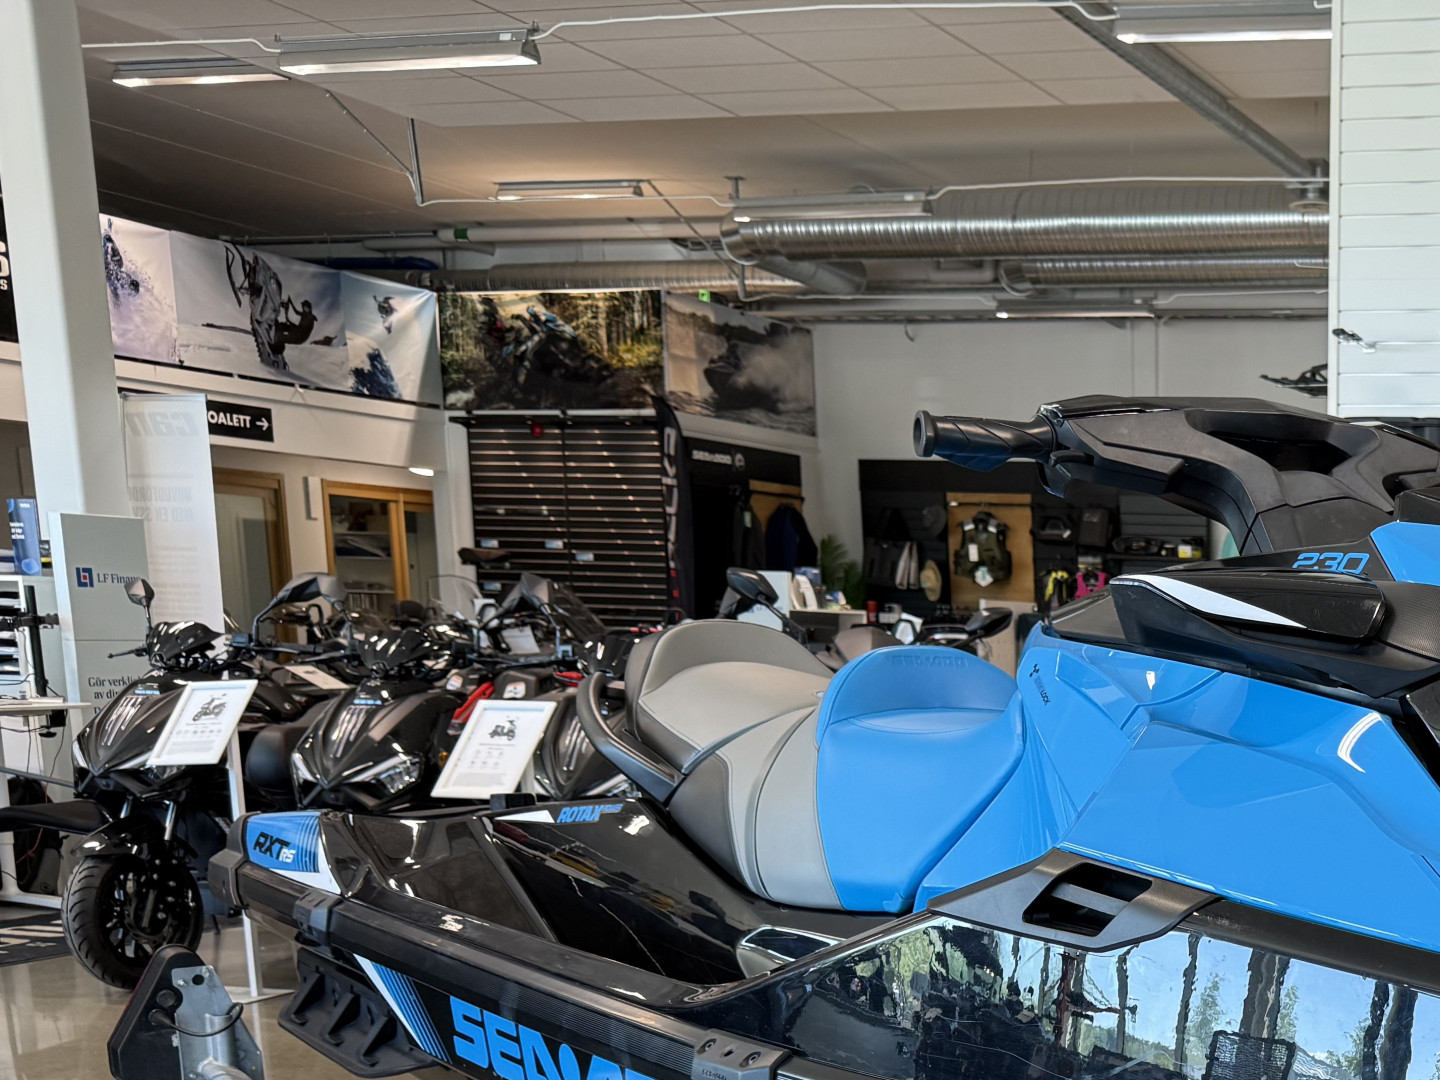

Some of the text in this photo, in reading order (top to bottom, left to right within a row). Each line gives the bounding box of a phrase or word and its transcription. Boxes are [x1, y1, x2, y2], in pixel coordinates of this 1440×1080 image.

[207, 410, 252, 429] OALETT
[1292, 551, 1370, 575] 230
[97, 573, 109, 583] LF
[88, 677, 106, 687] Gör
[94, 691, 104, 699] av
[556, 805, 604, 824] ROTAX
